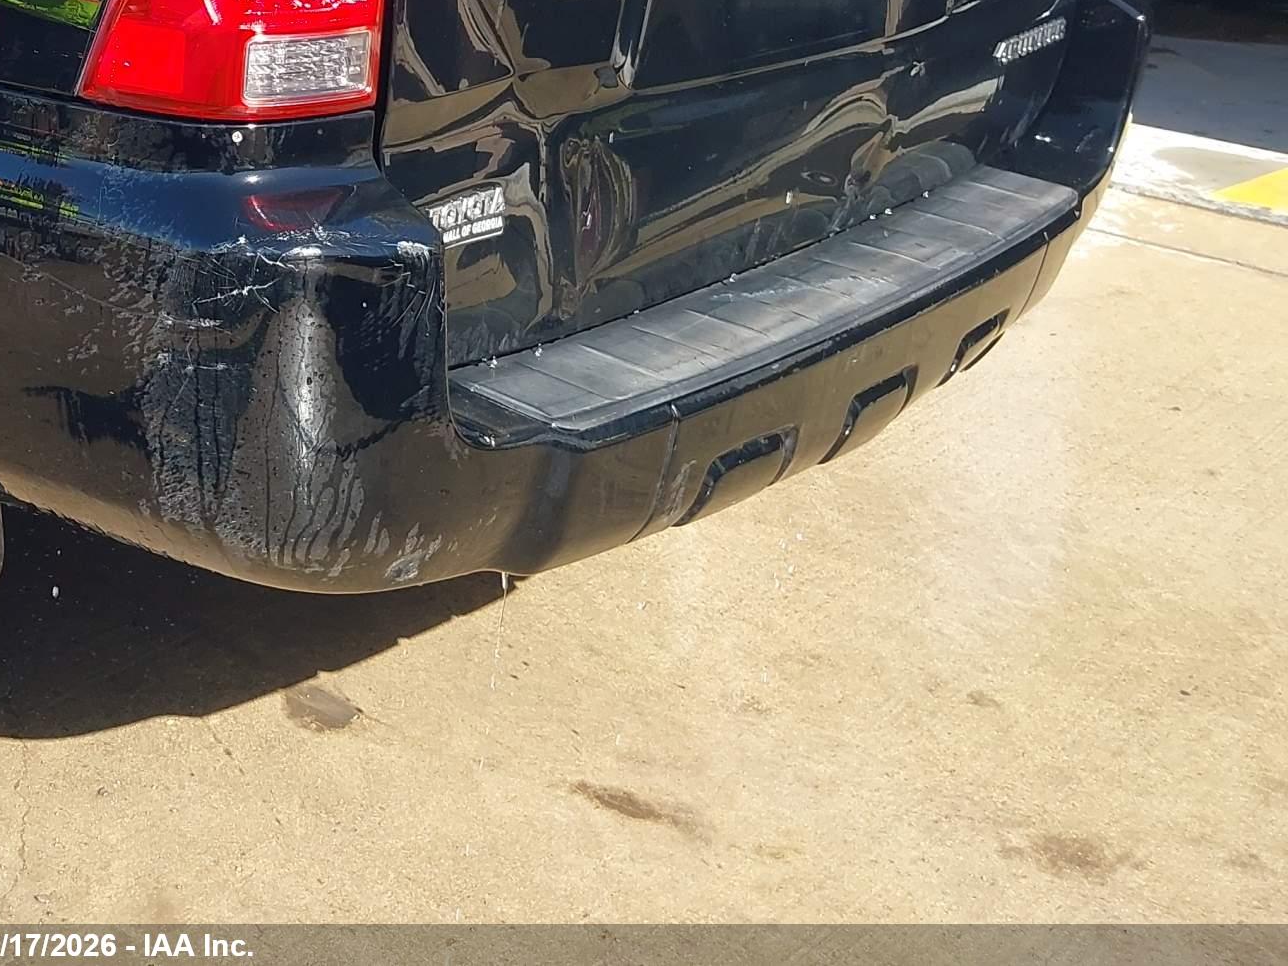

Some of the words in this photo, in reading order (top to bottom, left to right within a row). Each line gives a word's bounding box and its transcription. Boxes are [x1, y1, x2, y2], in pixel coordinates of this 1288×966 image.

[425, 187, 506, 231] TOYOTA
[461, 224, 472, 238] OF
[472, 216, 504, 234] GEORGIA
